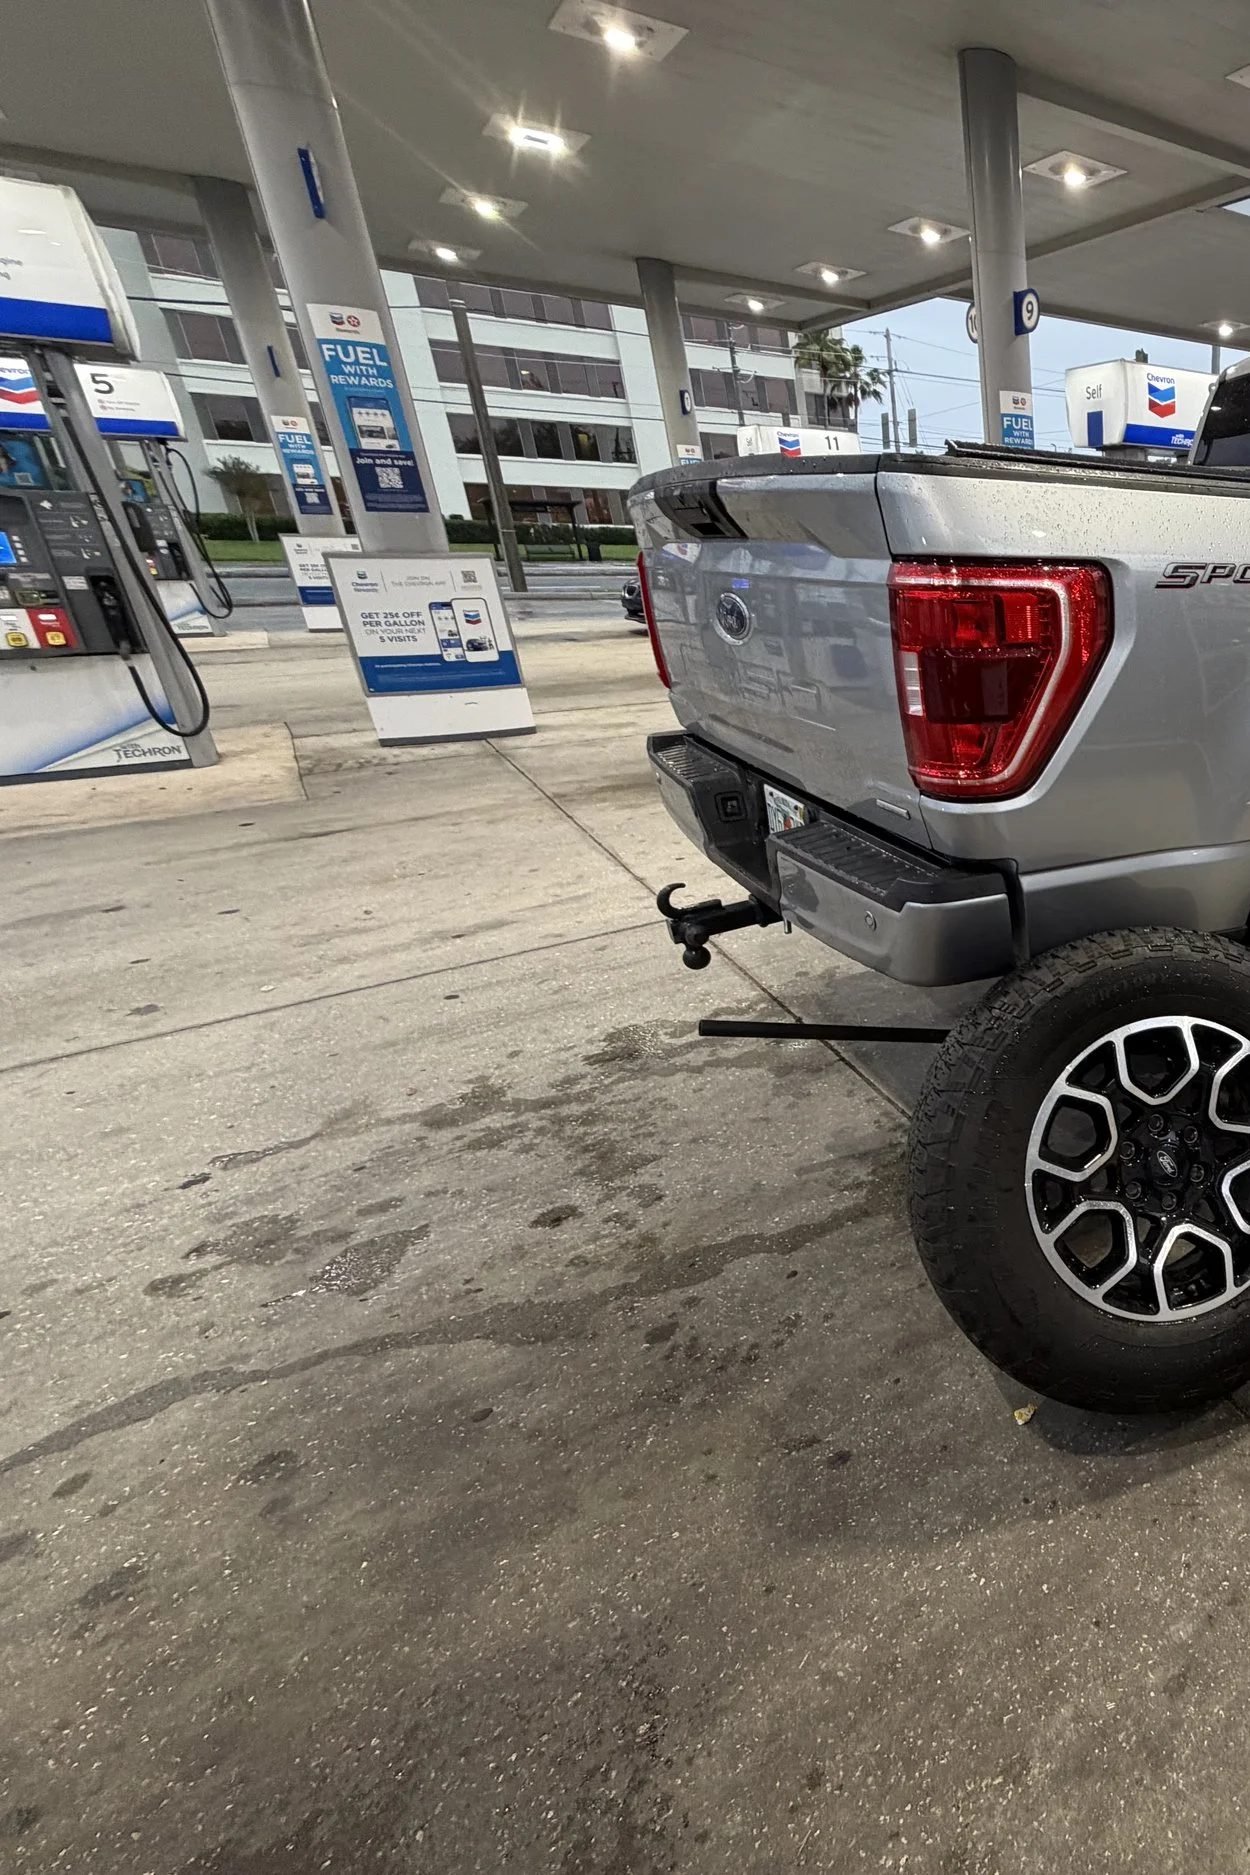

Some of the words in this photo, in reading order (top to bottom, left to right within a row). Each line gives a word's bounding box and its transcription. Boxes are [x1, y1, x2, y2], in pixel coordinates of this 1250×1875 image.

[1026, 301, 1034, 320] 9
[321, 344, 388, 367] FUEL
[341, 364, 378, 376] WITH
[90, 373, 114, 394] 5
[329, 375, 394, 389] REWARDS
[1147, 373, 1175, 384] Chevron
[1085, 384, 1102, 400] Self
[1003, 416, 1033, 430] FUEL
[277, 434, 312, 444] FUEL
[825, 436, 840, 451] 11
[402, 611, 422, 619] OFF
[362, 620, 383, 628] PER
[384, 619, 425, 627] GALLON
[405, 627, 426, 635] NEXT
[379, 635, 386, 643] 5
[386, 635, 418, 643] VISITS
[113, 745, 182, 763] TECHRON
